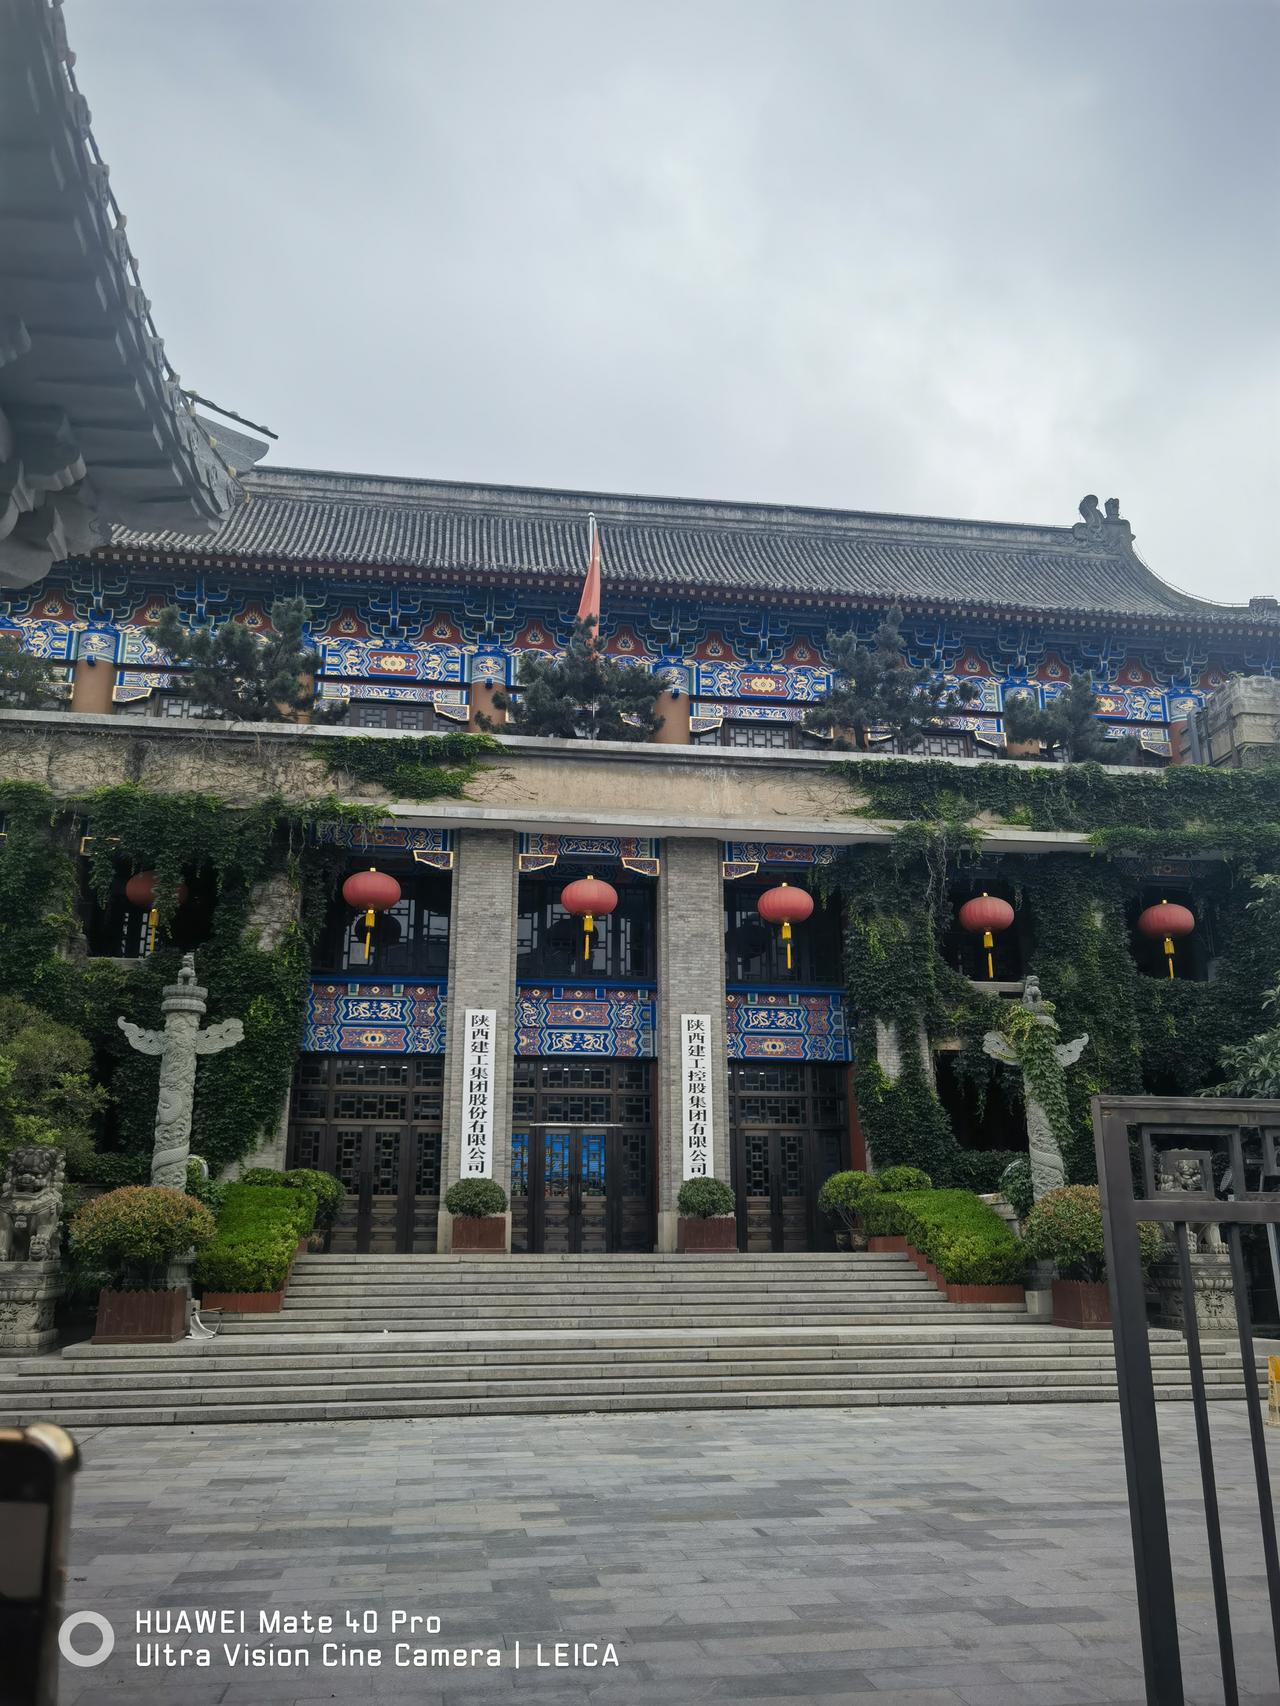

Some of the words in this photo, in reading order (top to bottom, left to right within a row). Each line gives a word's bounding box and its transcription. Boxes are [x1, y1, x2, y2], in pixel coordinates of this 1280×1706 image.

[467, 1014, 490, 1174] 陕西建工集团股份有限公司
[687, 1019, 708, 1176] 陕西建工控股集团有限公司
